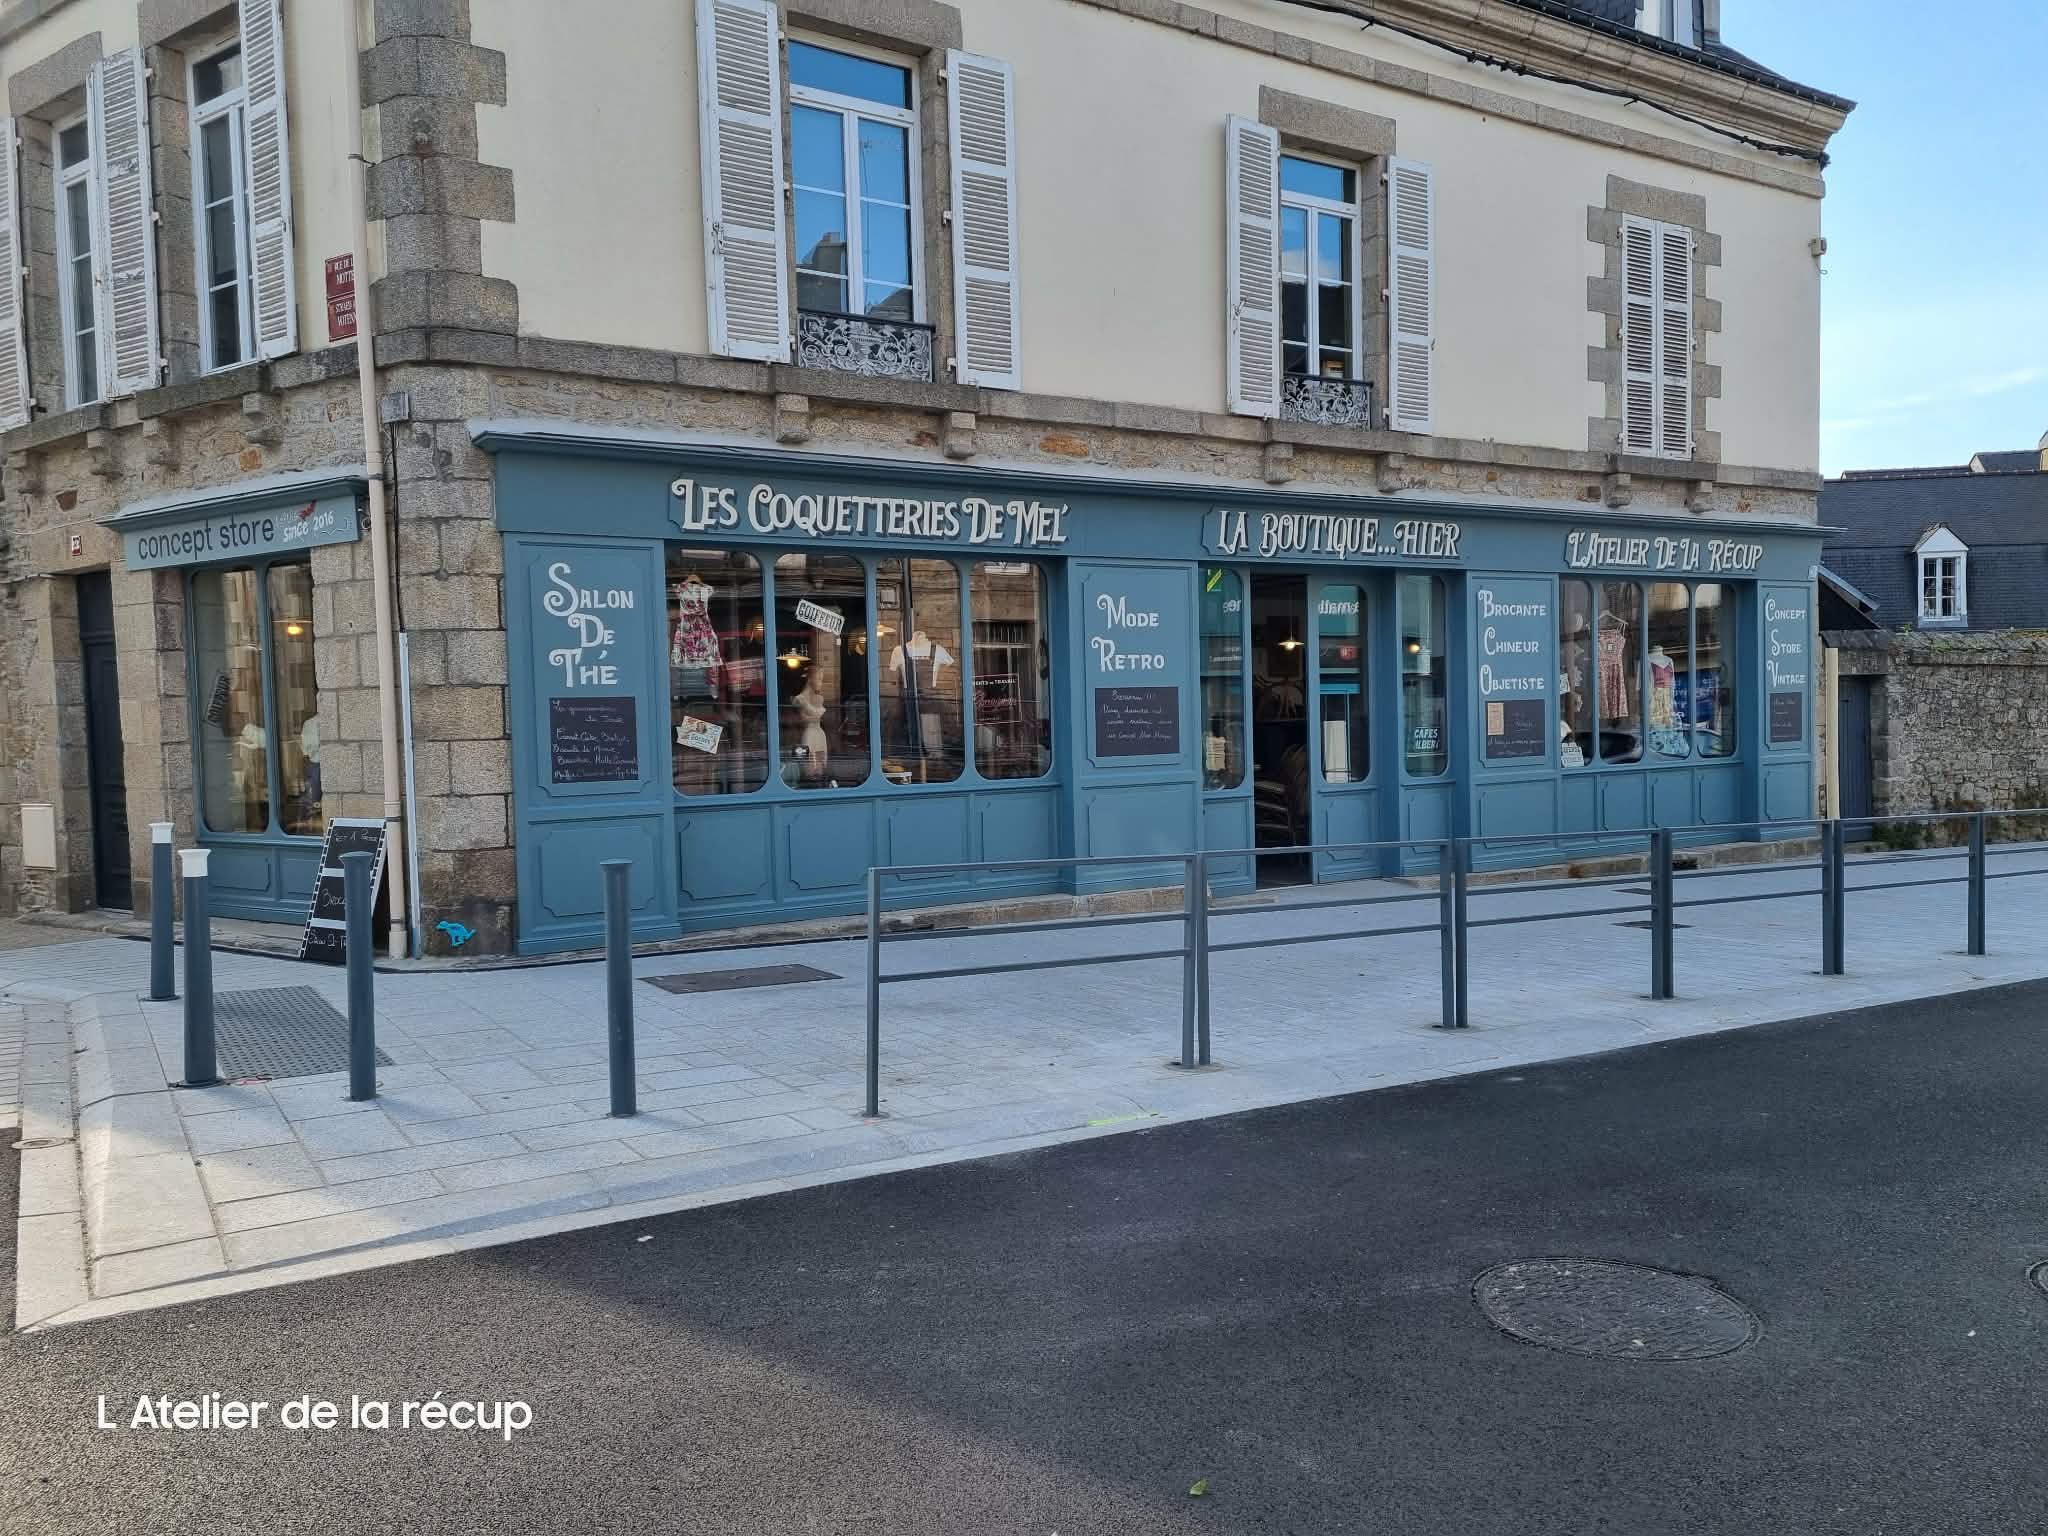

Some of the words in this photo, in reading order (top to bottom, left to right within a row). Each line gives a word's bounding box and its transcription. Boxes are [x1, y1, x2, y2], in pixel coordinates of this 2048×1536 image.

[283, 521, 309, 544] since
[313, 511, 334, 531] 2016
[671, 479, 738, 531] LES
[747, 484, 960, 537] COQUETTERIES
[962, 498, 1003, 544] DE
[138, 519, 213, 560] concept
[220, 512, 275, 550] store
[1217, 510, 1249, 555] LA
[1568, 531, 1650, 568] L'ATELIER
[1654, 537, 1678, 570] DE
[1680, 538, 1700, 570] LA
[1708, 539, 1763, 572] RÉCUP
[543, 562, 634, 617] SALON
[1478, 590, 1547, 618] BROCANTE
[798, 602, 843, 633] COIFFEUR
[1096, 594, 1159, 630] MODE
[1765, 598, 1808, 622] CONCEPT
[567, 613, 616, 648] DE
[1484, 626, 1540, 655] CHINEUR
[1770, 629, 1802, 657] STORE
[548, 647, 619, 688] THÉ
[1091, 636, 1165, 672] RETRO
[1480, 664, 1545, 695] OBJETISTE
[1766, 660, 1807, 688] VINTAGE
[1414, 728, 1438, 739] CAFES
